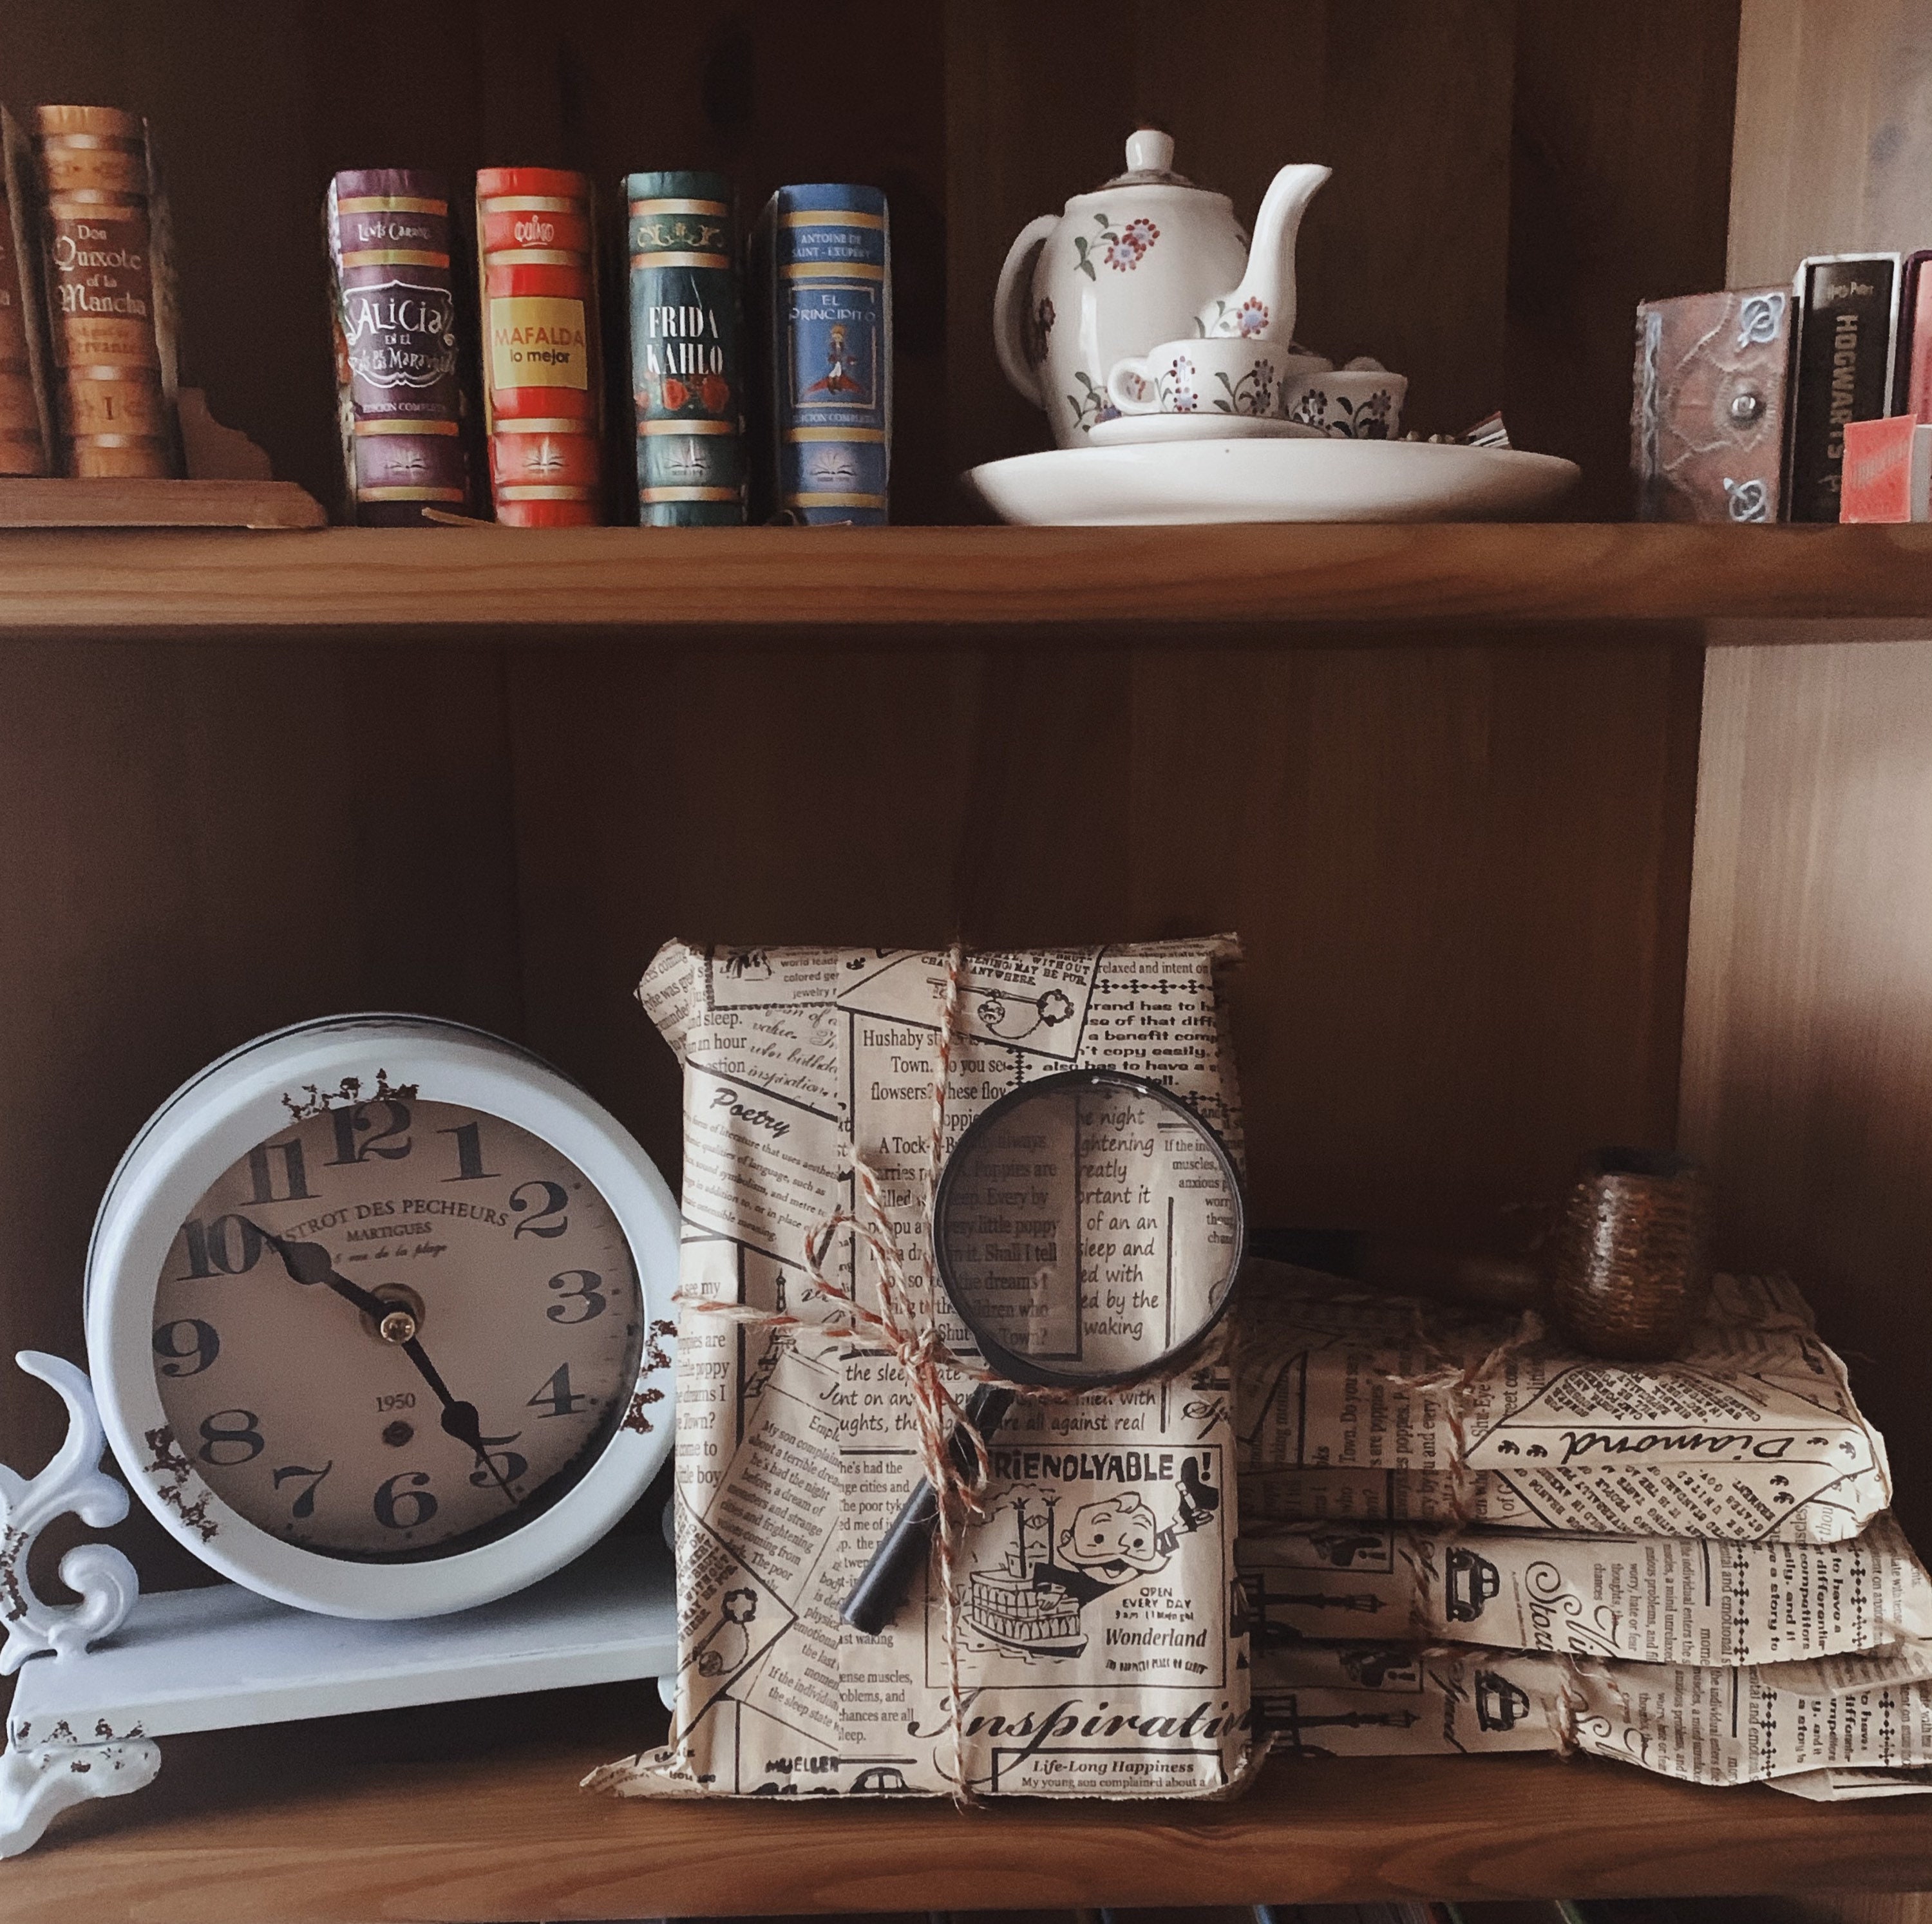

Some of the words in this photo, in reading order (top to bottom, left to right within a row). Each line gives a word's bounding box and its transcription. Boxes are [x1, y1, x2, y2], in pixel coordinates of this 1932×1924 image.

[78, 225, 106, 240] Don
[801, 233, 846, 243] ANTOINE
[59, 284, 146, 316] Mancha
[822, 295, 839, 305] EL
[649, 305, 719, 339] FRIDA
[789, 308, 875, 321] PRINCIPITO
[494, 326, 583, 348] MAFALDA
[510, 348, 522, 363] lo
[527, 351, 569, 365] mejor
[646, 343, 723, 375] KAHLO
[971, 963, 1036, 985] ANYWHERE
[1015, 961, 1038, 974] MAY
[1044, 969, 1057, 979] BE
[1032, 957, 1090, 975] WITHOUT
[1097, 961, 1136, 974] relaxed
[1139, 961, 1159, 974] and
[1162, 962, 1193, 974] intent
[784, 972, 821, 983] colored
[793, 988, 829, 999] jewelry
[1141, 1001, 1172, 1011] has
[1179, 1002, 1195, 1011] to
[705, 1012, 743, 1030] sleep.
[1115, 1016, 1135, 1026] of
[1141, 1016, 1175, 1026] that
[714, 1033, 748, 1050] hour
[864, 1029, 923, 1050] Hushaby
[1105, 1031, 1169, 1041] benefit
[1104, 1048, 1146, 1058] copy
[1152, 1046, 1210, 1057] easily.
[891, 1057, 933, 1073] Town.
[960, 1060, 985, 1077] you
[1043, 1061, 1078, 1071] also
[1122, 1061, 1140, 1071] to
[1146, 1061, 1188, 1071] have
[871, 1082, 933, 1100] flowsers?
[710, 1087, 790, 1139] Poetry
[1100, 1108, 1145, 1131] night
[323, 1100, 412, 1165] 12
[720, 1127, 760, 1149] literature
[762, 1144, 780, 1157] that
[437, 1121, 501, 1182] 1
[239, 1138, 321, 1206] 11
[749, 1158, 790, 1184] language,
[793, 1177, 814, 1192] such
[1179, 1177, 1220, 1189] anxious
[509, 1180, 568, 1239] 2
[771, 1189, 788, 1203] and
[790, 1197, 820, 1216] metre
[357, 1202, 395, 1220] DES
[403, 1200, 509, 1228] PECHEURS
[779, 1213, 802, 1231] place
[1087, 1211, 1104, 1231] of
[346, 1221, 432, 1242] MARTIGUES
[176, 1214, 261, 1280] 10
[1123, 1238, 1155, 1256] and
[1106, 1264, 1142, 1283] with
[547, 1270, 606, 1324] 3
[701, 1281, 721, 1297] my
[1106, 1289, 1125, 1315] by
[1133, 1289, 1159, 1308] the
[1084, 1317, 1143, 1341] waking
[153, 1319, 220, 1377] 9
[705, 1334, 725, 1348] are
[846, 1363, 871, 1382] the
[527, 1362, 585, 1419] 4
[1120, 1390, 1156, 1406] with
[375, 1393, 416, 1412] 1950
[1471, 1384, 1495, 1437] Shut-Eye
[1051, 1413, 1108, 1436] against
[1115, 1413, 1145, 1430] real
[199, 1409, 264, 1465] 8
[704, 1442, 717, 1456] to
[1559, 1431, 1795, 1465] Diamond
[470, 1431, 527, 1489] 5
[886, 1462, 902, 1474] the
[697, 1465, 722, 1488] boy
[860, 1481, 887, 1493] cities
[890, 1480, 909, 1492] and
[273, 1460, 332, 1518] 7
[804, 1481, 830, 1501] night
[1594, 1477, 1631, 1513] PEOPLE
[1660, 1475, 1707, 1522] STANDARD
[1677, 1470, 1722, 1514] UNITED
[374, 1471, 439, 1529] 6
[781, 1488, 811, 1511] dream
[859, 1502, 884, 1513] poor
[767, 1562, 793, 1583] poor
[1833, 1558, 1842, 1573] to
[1140, 1587, 1173, 1597] OPEN
[1833, 1579, 1843, 1621] have
[1122, 1599, 1158, 1608] EVERY
[1166, 1599, 1191, 1608] DAY
[1629, 1596, 1642, 1617] hate
[1768, 1584, 1780, 1630] story
[1786, 1592, 1796, 1625] and
[1721, 1596, 1732, 1655] emotional
[855, 1632, 894, 1648] waking
[1104, 1628, 1208, 1648] Wonderland
[1771, 1637, 1780, 1651] to
[867, 1670, 913, 1684] muscles,
[885, 1690, 905, 1702] and
[785, 1695, 809, 1715] sleep
[810, 1706, 830, 1724] state
[882, 1711, 898, 1722] are
[901, 1709, 914, 1722] all
[1032, 1760, 1108, 1775] Life-Long
[1112, 1760, 1195, 1773] Happiness
[1021, 1777, 1039, 1789] My
[1041, 1778, 1075, 1789] young
[1077, 1778, 1097, 1787] son
[1099, 1777, 1164, 1789] complained
[1166, 1777, 1193, 1787] about
